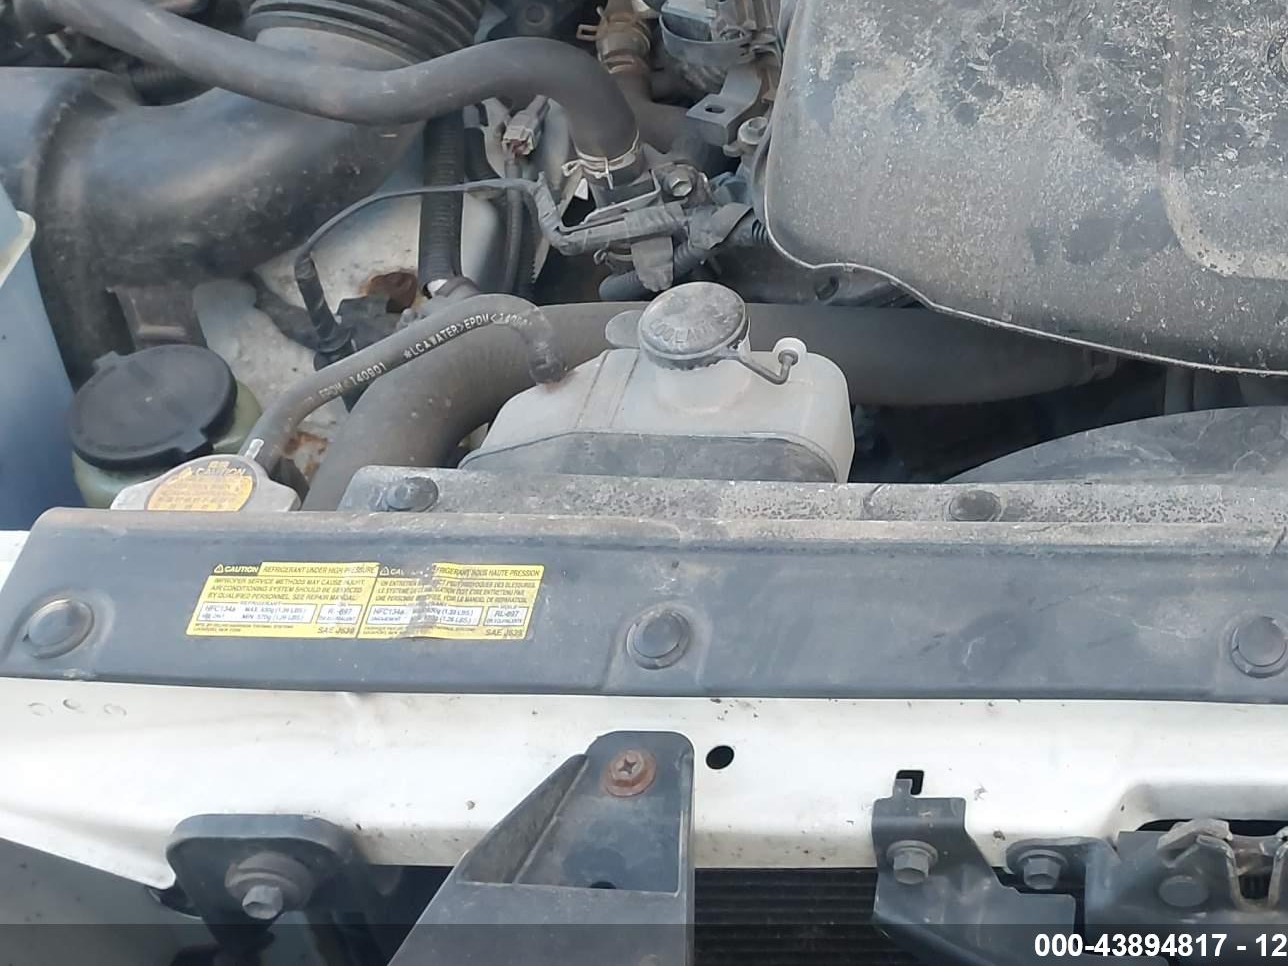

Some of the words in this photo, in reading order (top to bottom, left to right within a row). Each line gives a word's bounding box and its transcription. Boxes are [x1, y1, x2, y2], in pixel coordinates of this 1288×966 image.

[224, 565, 258, 574] CAUTION
[307, 566, 326, 574] UNDER
[488, 569, 509, 577] HAUTE
[510, 569, 540, 577] PRESSION
[485, 629, 503, 637] SAE
